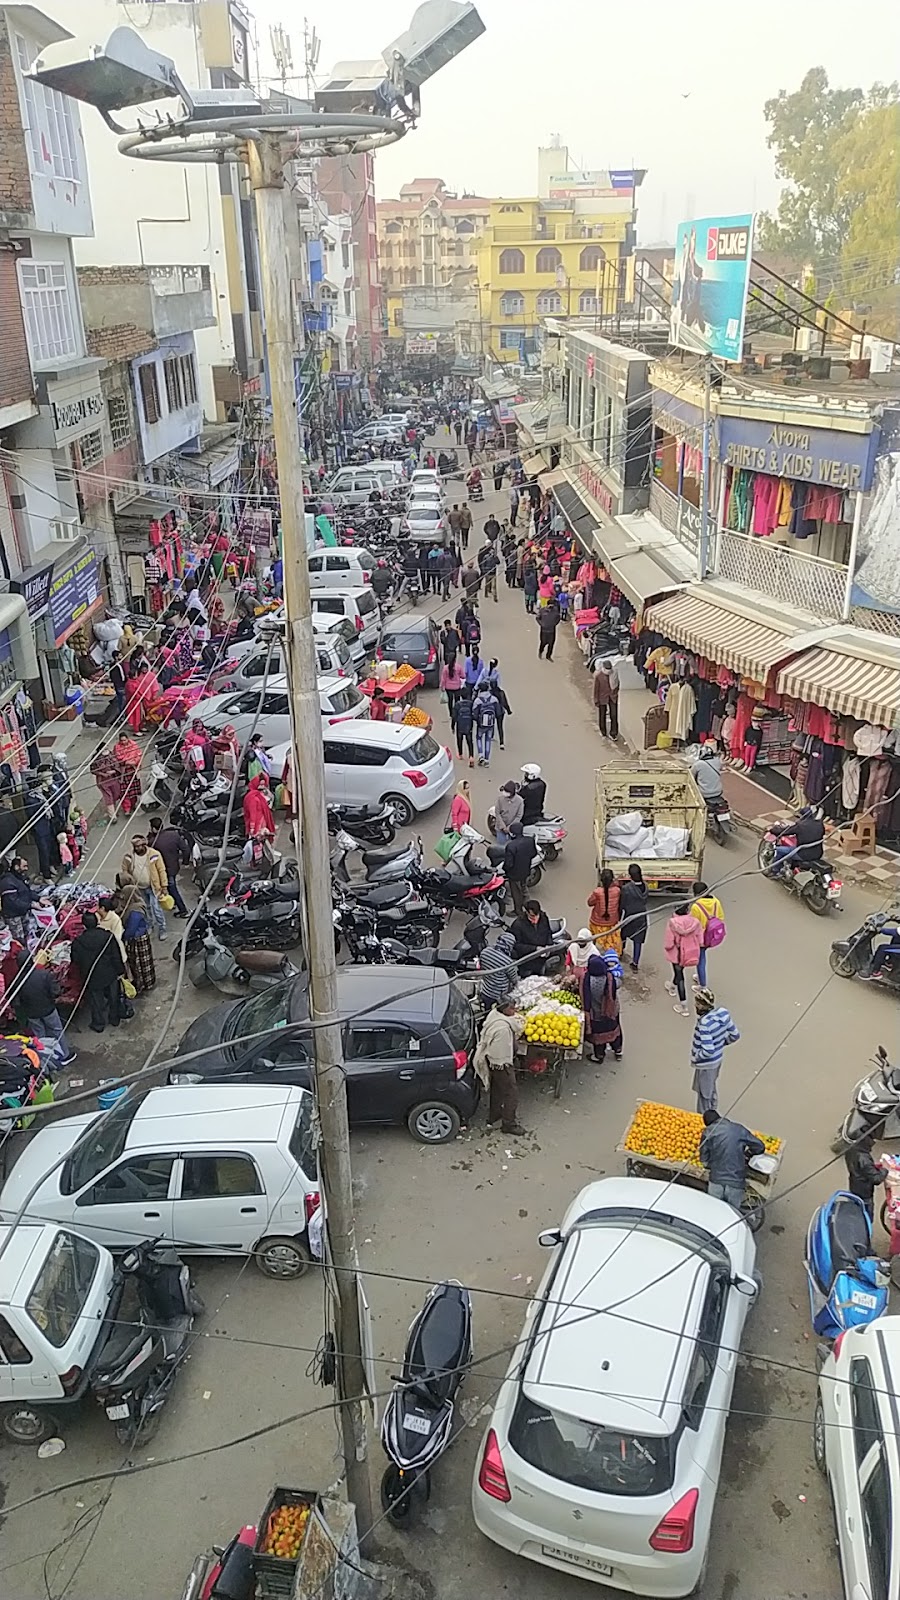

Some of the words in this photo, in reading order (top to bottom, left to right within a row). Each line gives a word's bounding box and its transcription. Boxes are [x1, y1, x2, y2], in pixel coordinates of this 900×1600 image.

[718, 232, 747, 255] DUKE
[766, 424, 811, 451] Arora
[726, 442, 767, 469] SHIRTS
[768, 450, 778, 472] &
[782, 453, 814, 479] KIDS
[818, 458, 863, 487] WEAR
